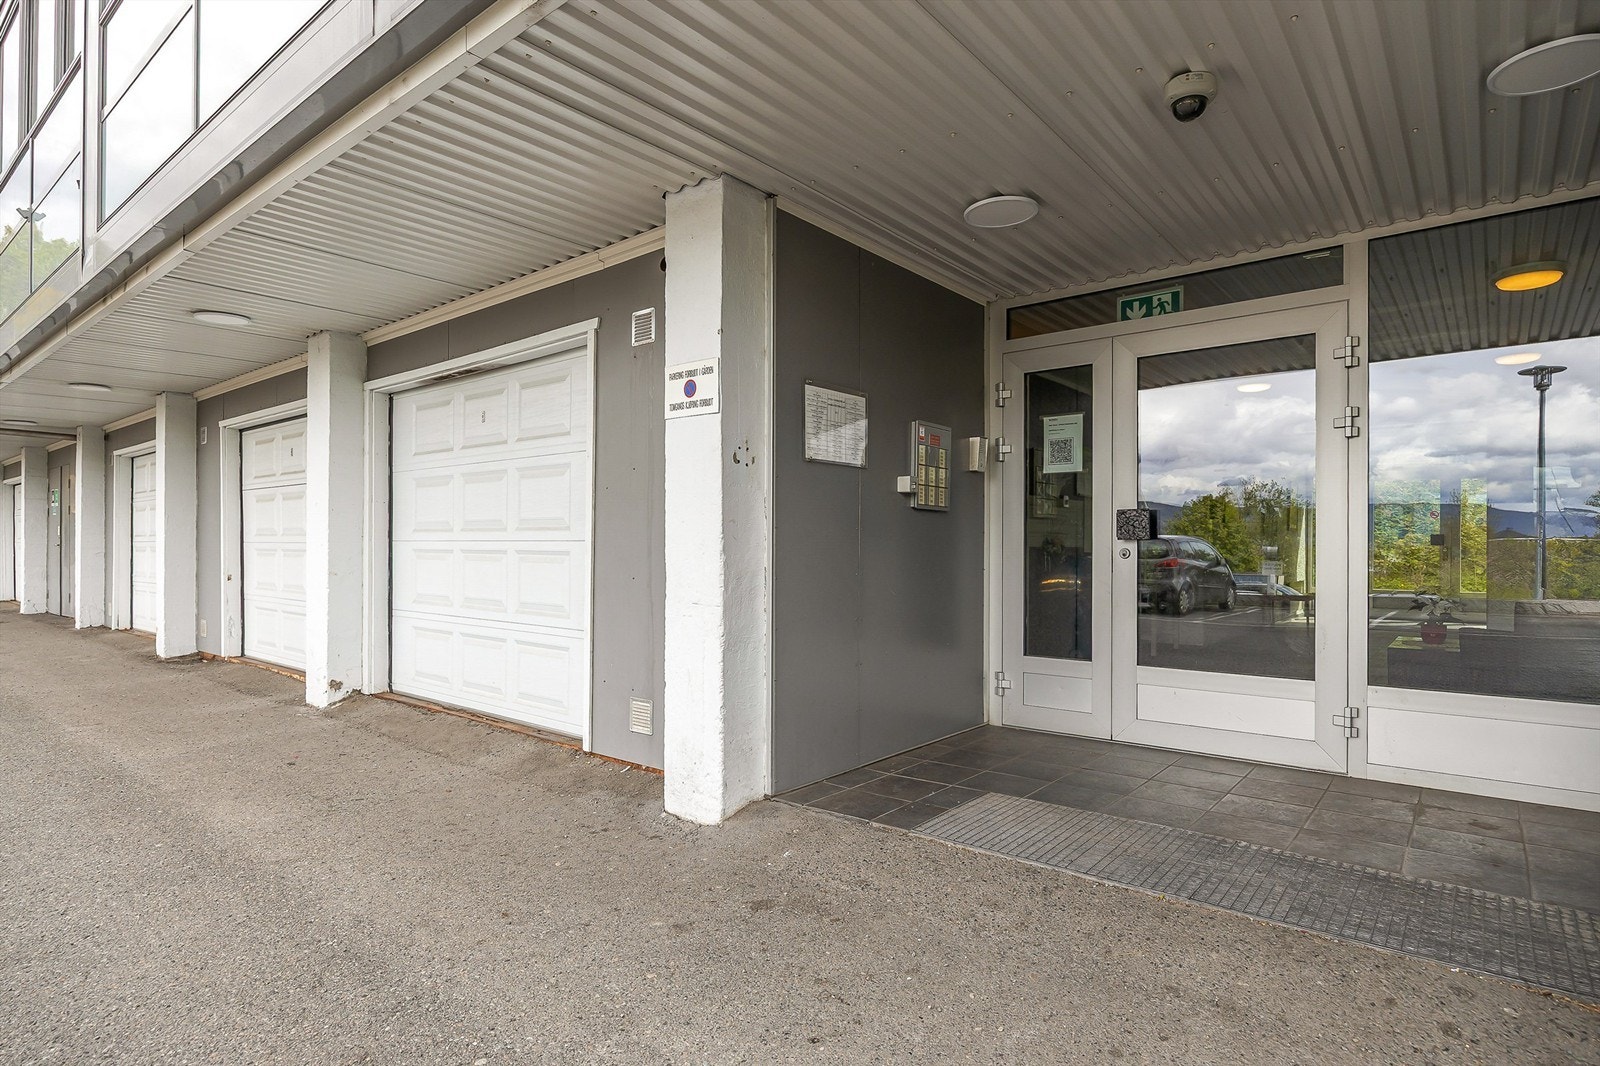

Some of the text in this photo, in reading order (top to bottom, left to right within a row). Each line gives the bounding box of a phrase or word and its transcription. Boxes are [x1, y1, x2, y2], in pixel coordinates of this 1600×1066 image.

[685, 368, 698, 378] FORBUDT
[702, 365, 714, 375] GÅRDEN
[700, 398, 714, 407] FORBUDT
